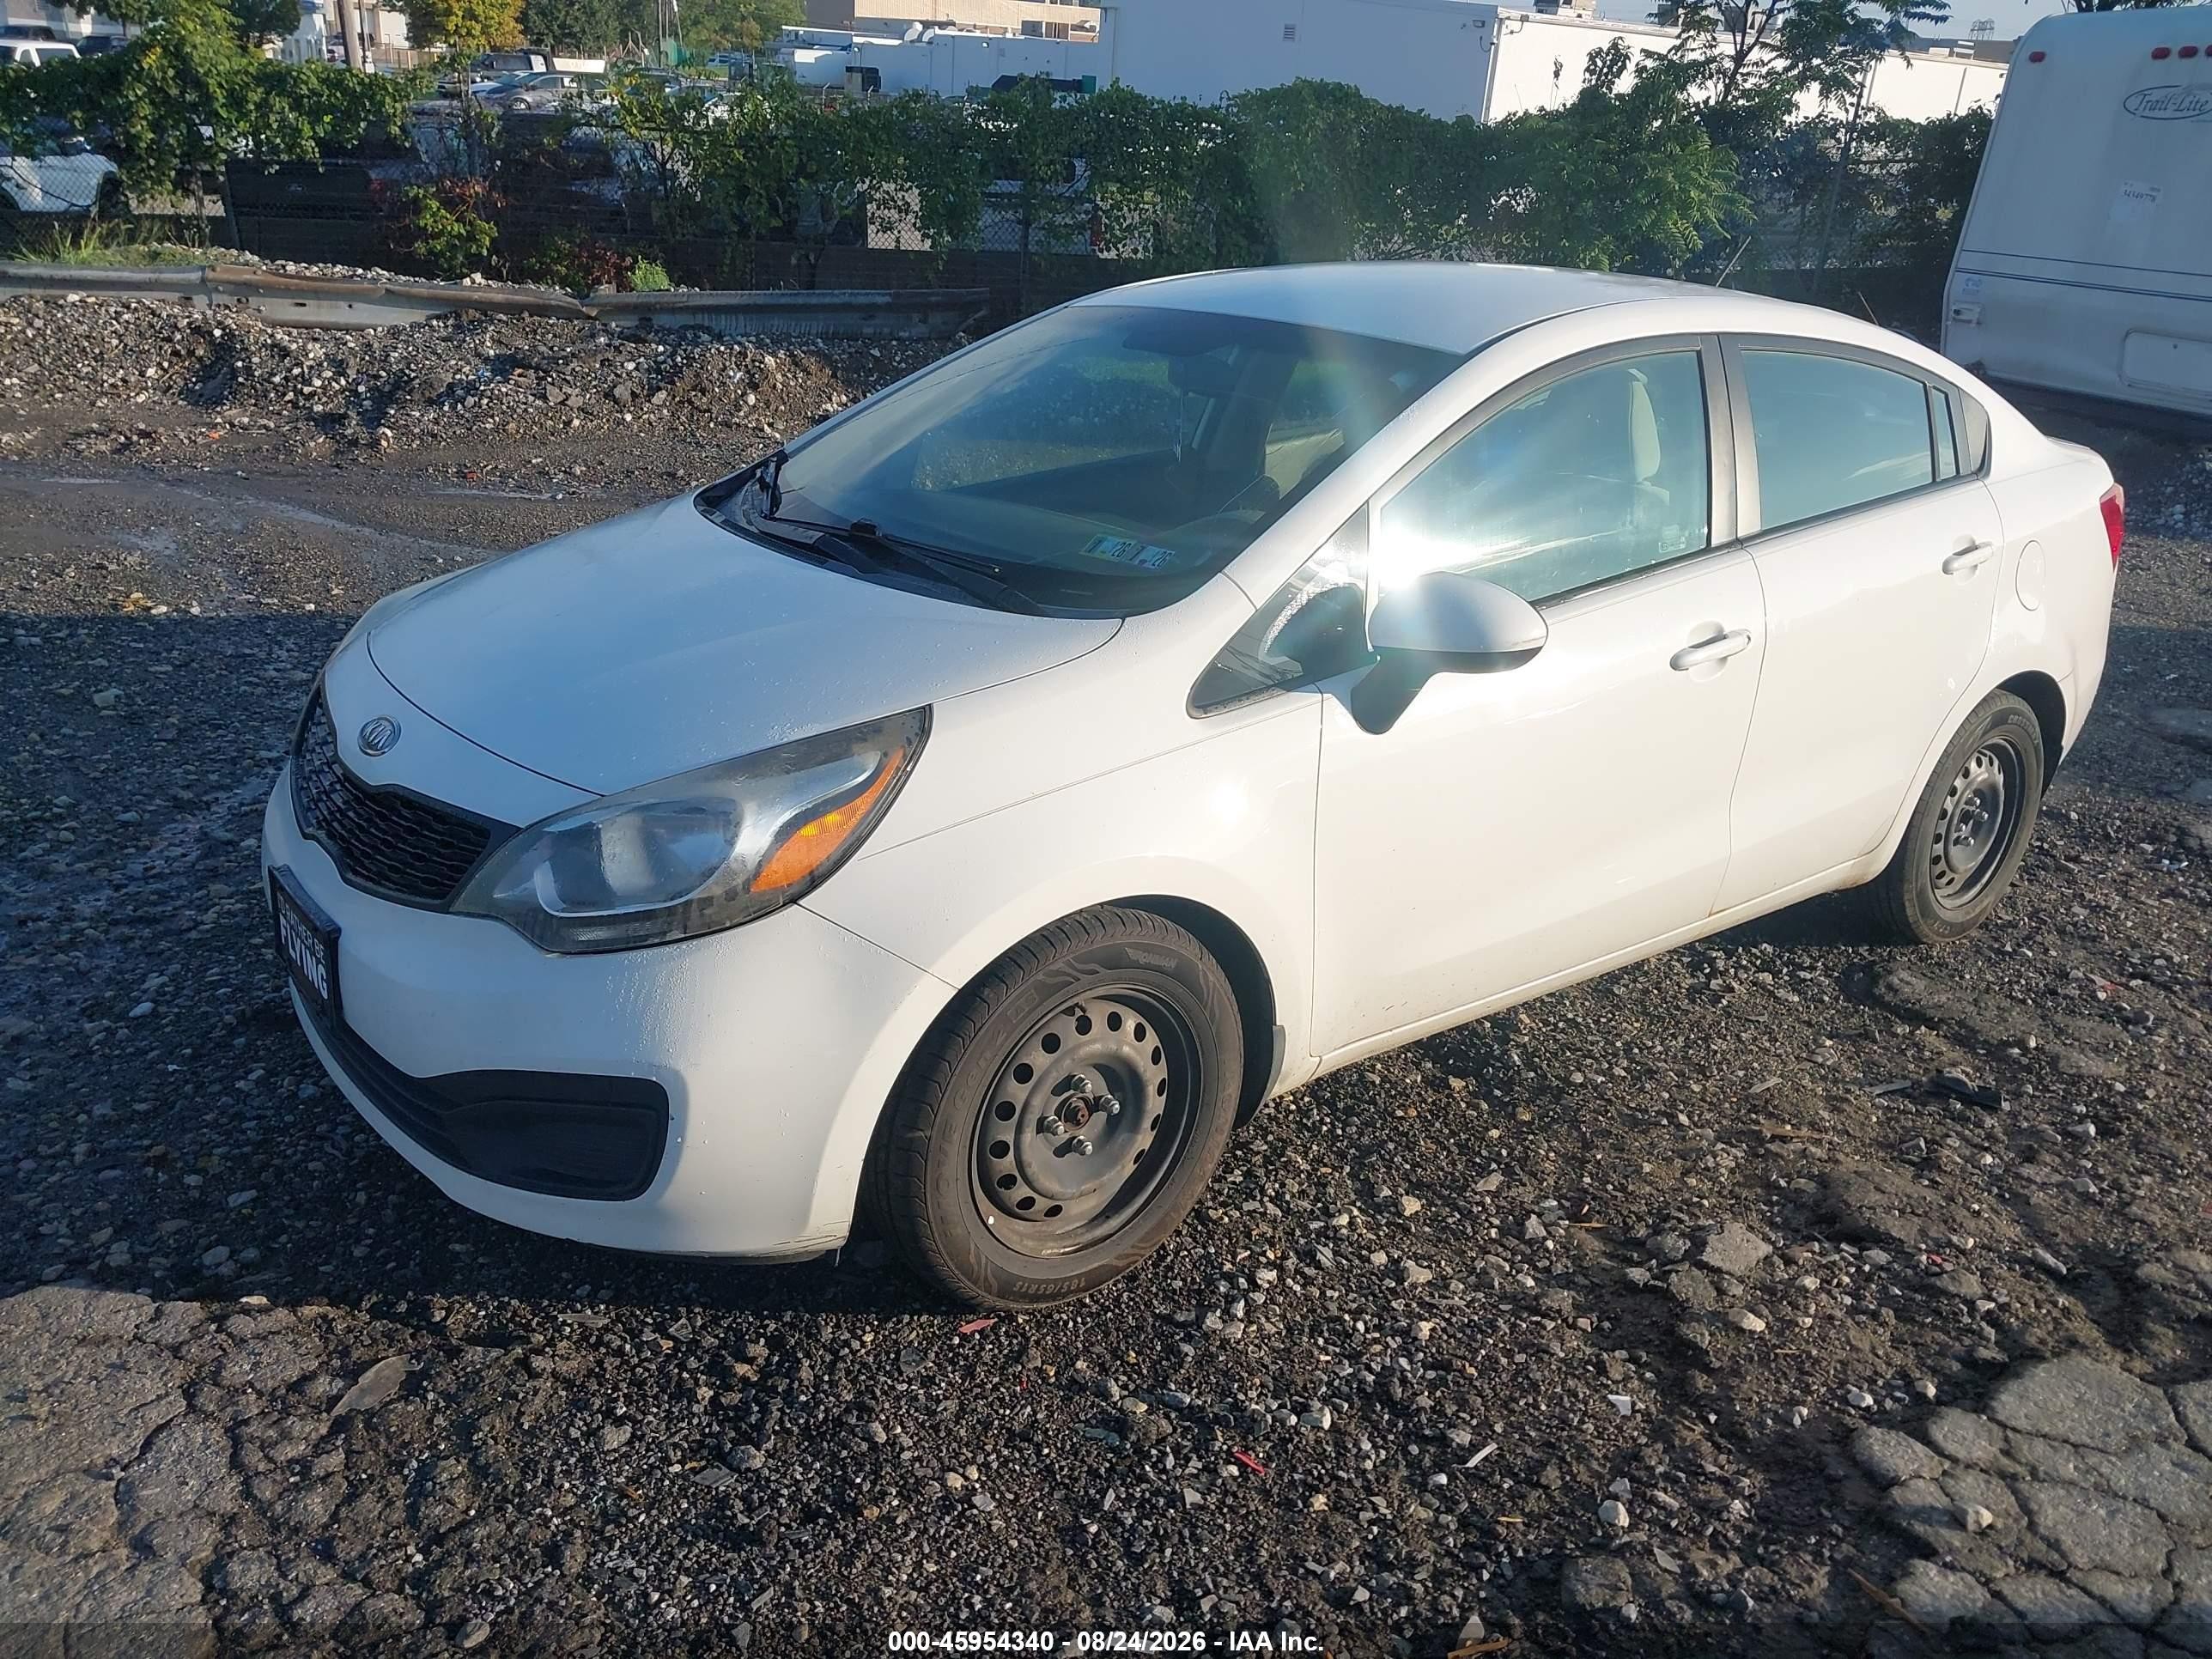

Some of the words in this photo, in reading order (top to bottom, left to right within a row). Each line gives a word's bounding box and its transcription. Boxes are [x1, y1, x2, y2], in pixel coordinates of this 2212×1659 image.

[2134, 92, 2209, 112] Trail-Lite
[285, 902, 314, 951] RATHER
[313, 937, 325, 964] BE
[279, 913, 328, 1000] FLYING
[1013, 1277, 1086, 1294] 185/65R15
